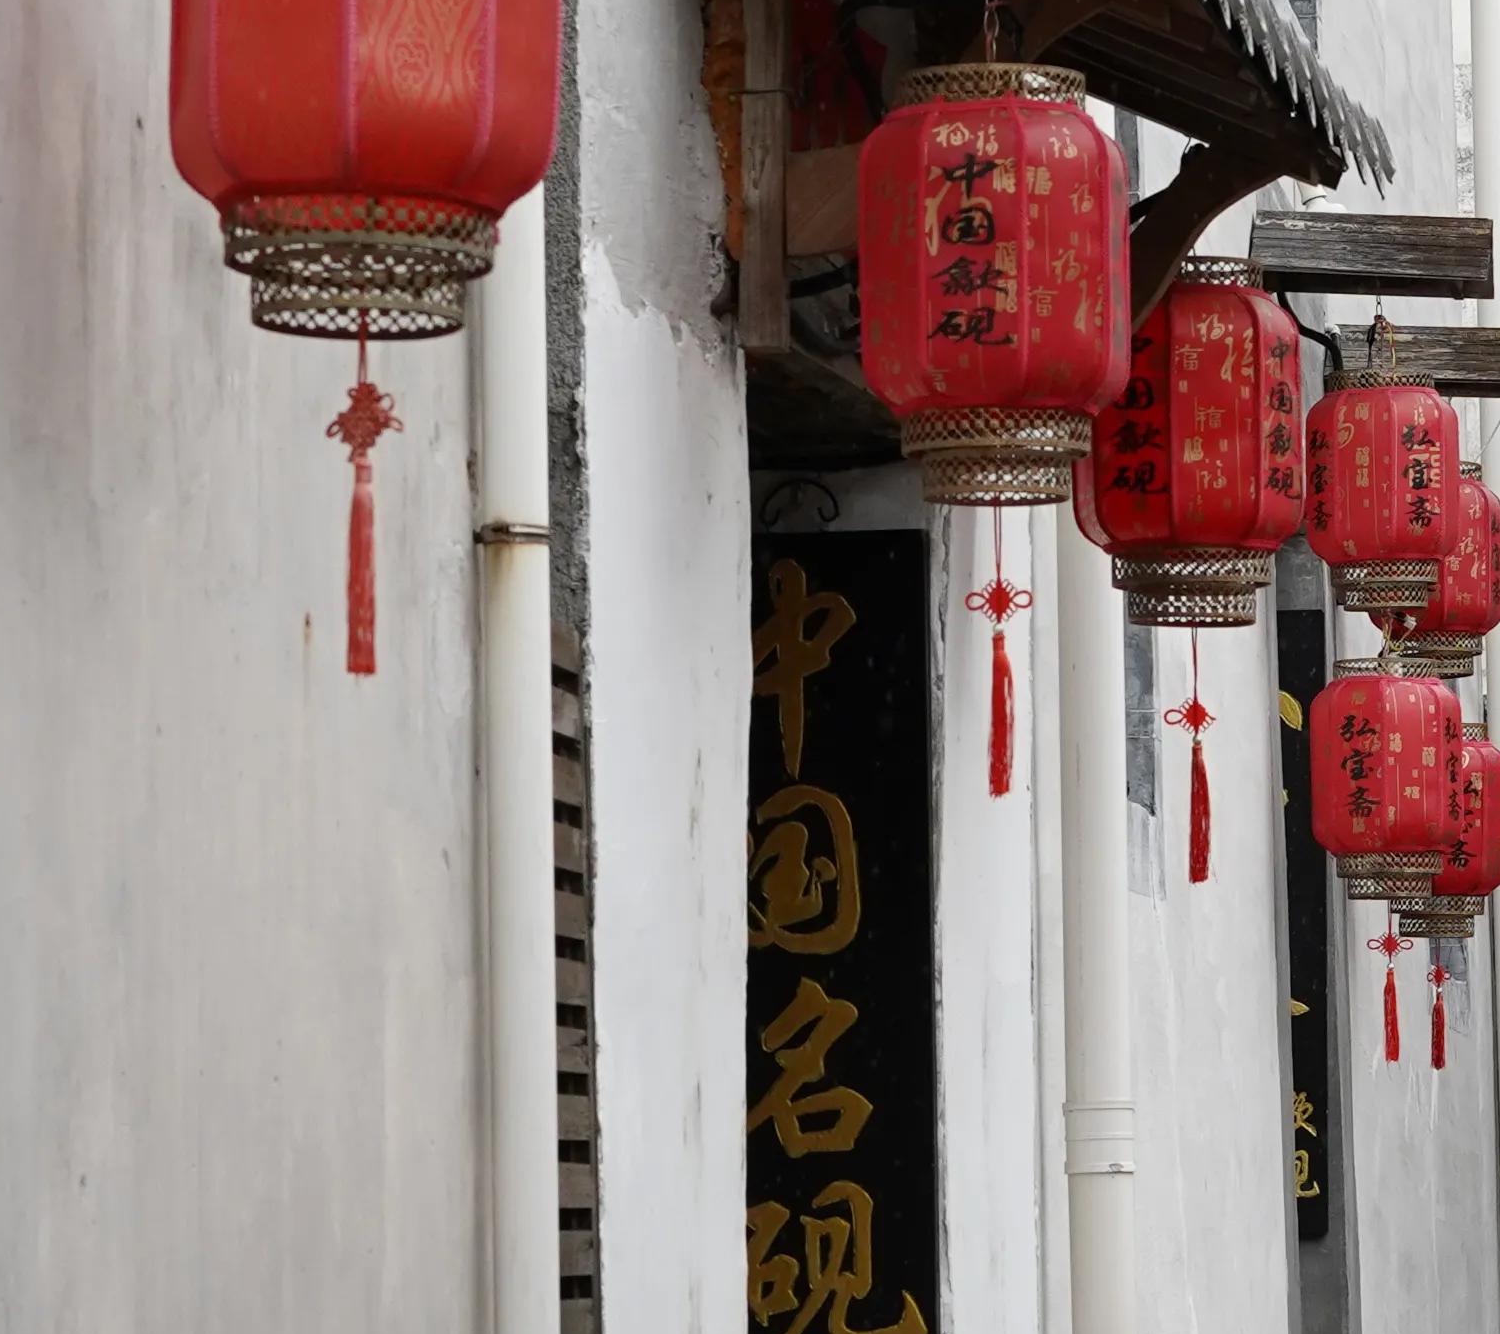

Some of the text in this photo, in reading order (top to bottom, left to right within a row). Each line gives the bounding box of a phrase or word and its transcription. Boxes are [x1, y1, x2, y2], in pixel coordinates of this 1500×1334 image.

[926, 152, 1015, 347] 中国歙砚
[1265, 335, 1302, 500] 中国歙砚
[1401, 424, 1442, 529] 弘宝斋
[1336, 714, 1381, 819] 弘宝斋
